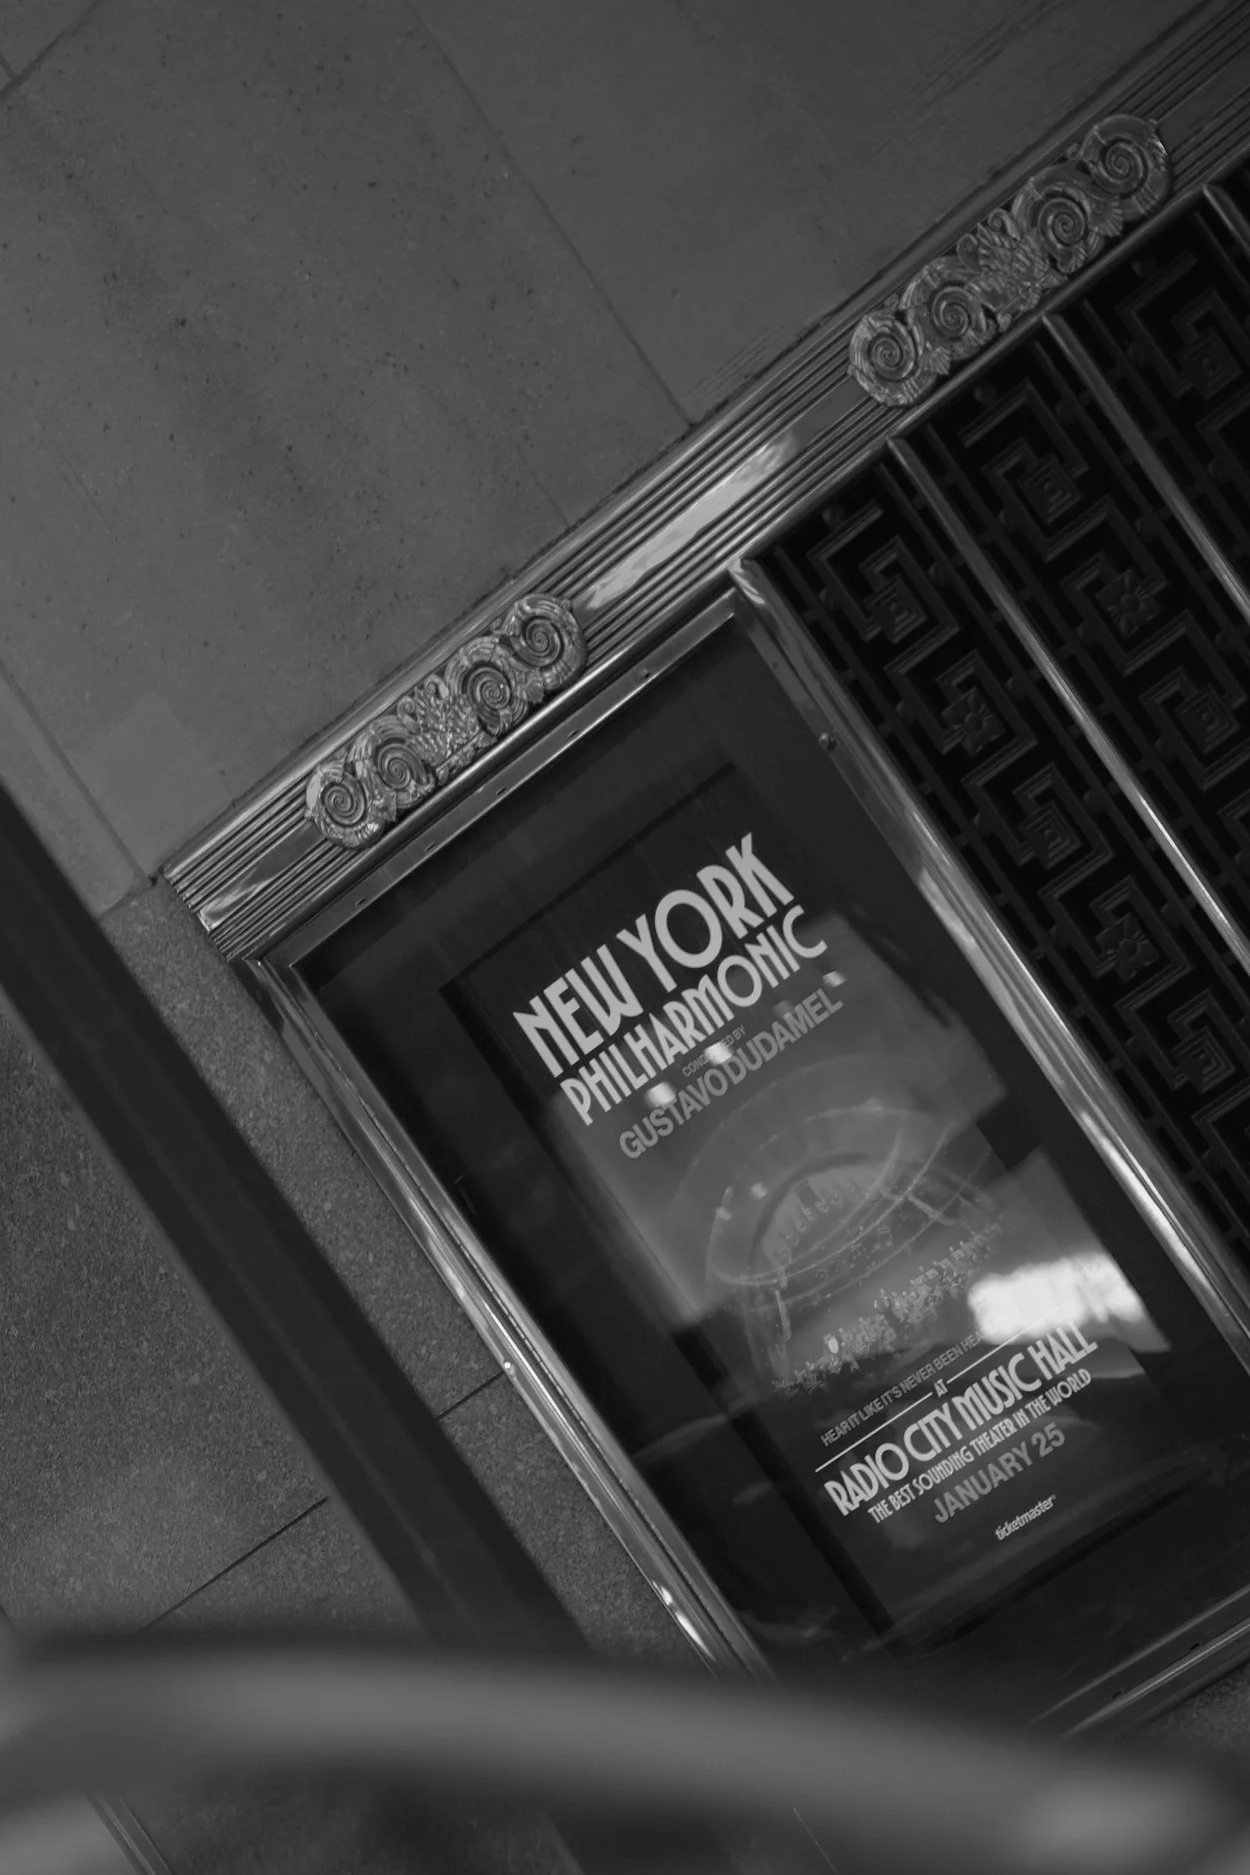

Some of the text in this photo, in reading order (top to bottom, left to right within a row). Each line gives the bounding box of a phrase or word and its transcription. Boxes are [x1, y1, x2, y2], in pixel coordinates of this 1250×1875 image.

[512, 832, 795, 1078] NEW YORK
[560, 905, 828, 1126] PHILHARMONIC
[619, 989, 844, 1159] GUSTAVO DUDAMEL
[682, 1024, 747, 1077] CONDED BY
[820, 1419, 852, 1447] HEAR
[847, 1412, 861, 1429] IT
[857, 1398, 884, 1421] LIKE
[899, 1363, 936, 1393] NEVER
[932, 1344, 964, 1371] BEEN
[824, 1320, 1099, 1516] RADIO CITY MUSIC HALL
[867, 1368, 1092, 1524] THE BEST SOUNDING THEATER IN THE WORLD
[934, 1378, 949, 1397] AT
[934, 1422, 1066, 1523] JANUARY 25
[994, 1495, 1054, 1541] ticketmaster
